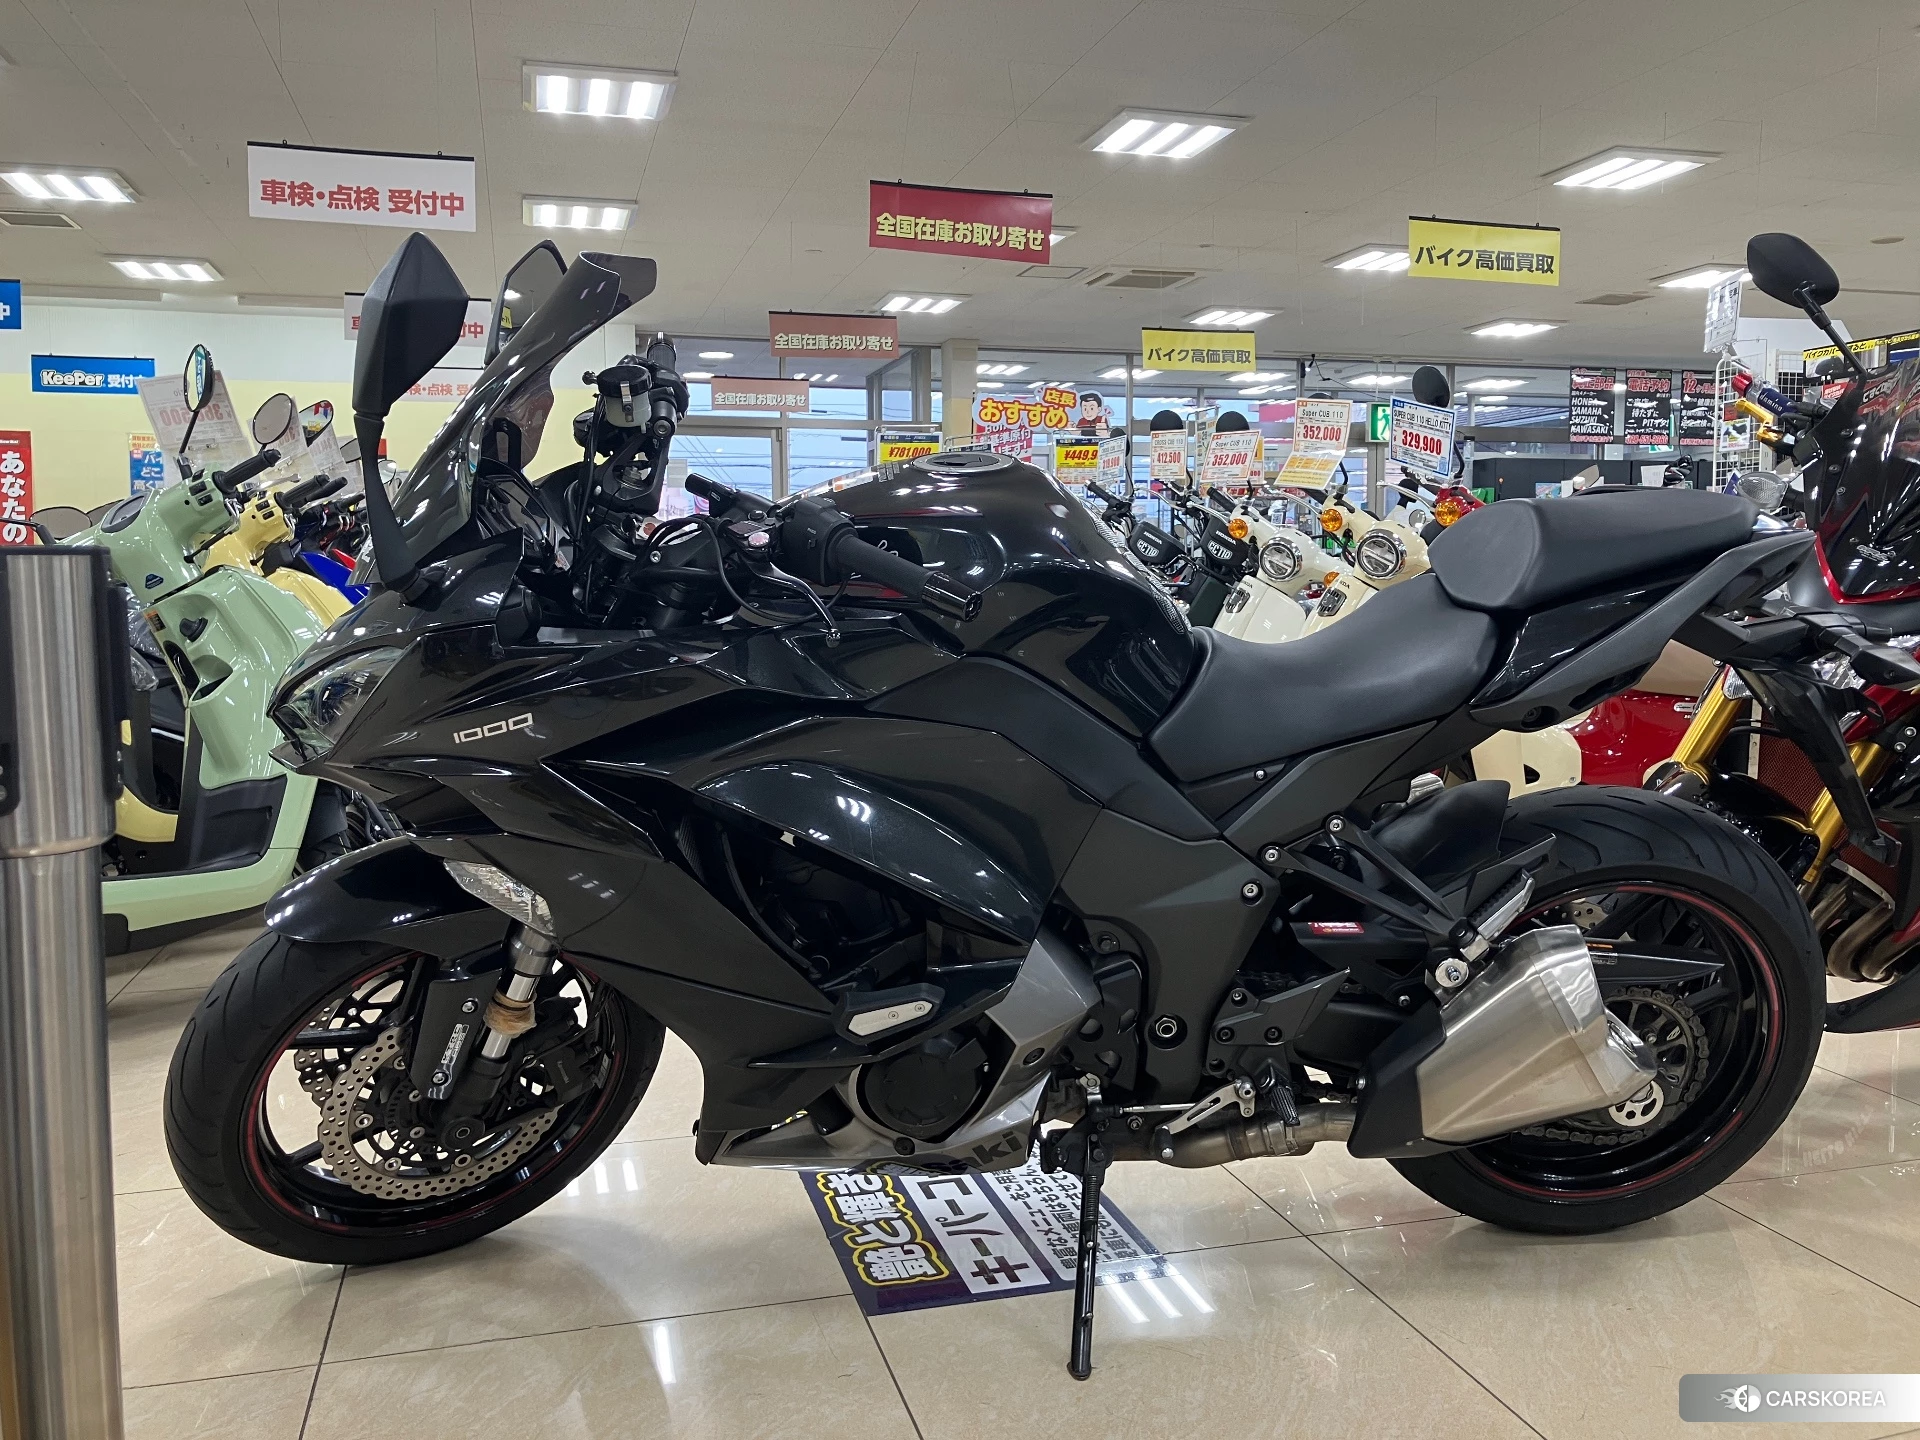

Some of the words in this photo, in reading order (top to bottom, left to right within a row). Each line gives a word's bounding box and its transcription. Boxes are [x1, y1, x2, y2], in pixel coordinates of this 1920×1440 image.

[260, 179, 380, 212] 車検・点検
[388, 188, 465, 217] 受付中
[876, 212, 1045, 251] 全国在庫お取り寄せ
[1414, 245, 1555, 275] バイク高価買取
[774, 333, 894, 352] 全国在庫お取り寄せ
[1147, 347, 1251, 364] バイク高価買取
[41, 369, 104, 387] KeePer
[107, 374, 146, 389] 受付
[1628, 378, 1671, 392] 電話予約
[407, 383, 453, 396] 検・点検
[714, 391, 806, 406] 全国在庫お取り寄せ
[1044, 389, 1076, 408] 店長
[1760, 392, 1783, 411] domino
[979, 397, 1068, 429] おすすめ
[1302, 409, 1317, 418] Super
[1318, 410, 1330, 418] CUB
[1393, 409, 1406, 419] SUPER
[1407, 412, 1415, 421] CUB
[1425, 416, 1439, 428] HELLO
[1439, 420, 1451, 431] KITTY
[1571, 407, 1602, 415] YAMAHA
[1571, 416, 1598, 424] SUZUKI
[1302, 424, 1342, 442] 352,000
[1570, 425, 1609, 434] KAWASAKI
[1402, 429, 1442, 455] 329,900
[888, 446, 932, 458] ¥781,000
[1156, 452, 1182, 464] 412,500
[1212, 452, 1249, 467] 352,000
[0, 450, 28, 543] あなたの
[1144, 531, 1163, 545] HONDA
[1215, 529, 1237, 546] HONDA
[453, 712, 533, 744] 1000
[826, 1174, 938, 1281] 艶と輝き
[916, 1174, 1030, 1285] キーパーコ
